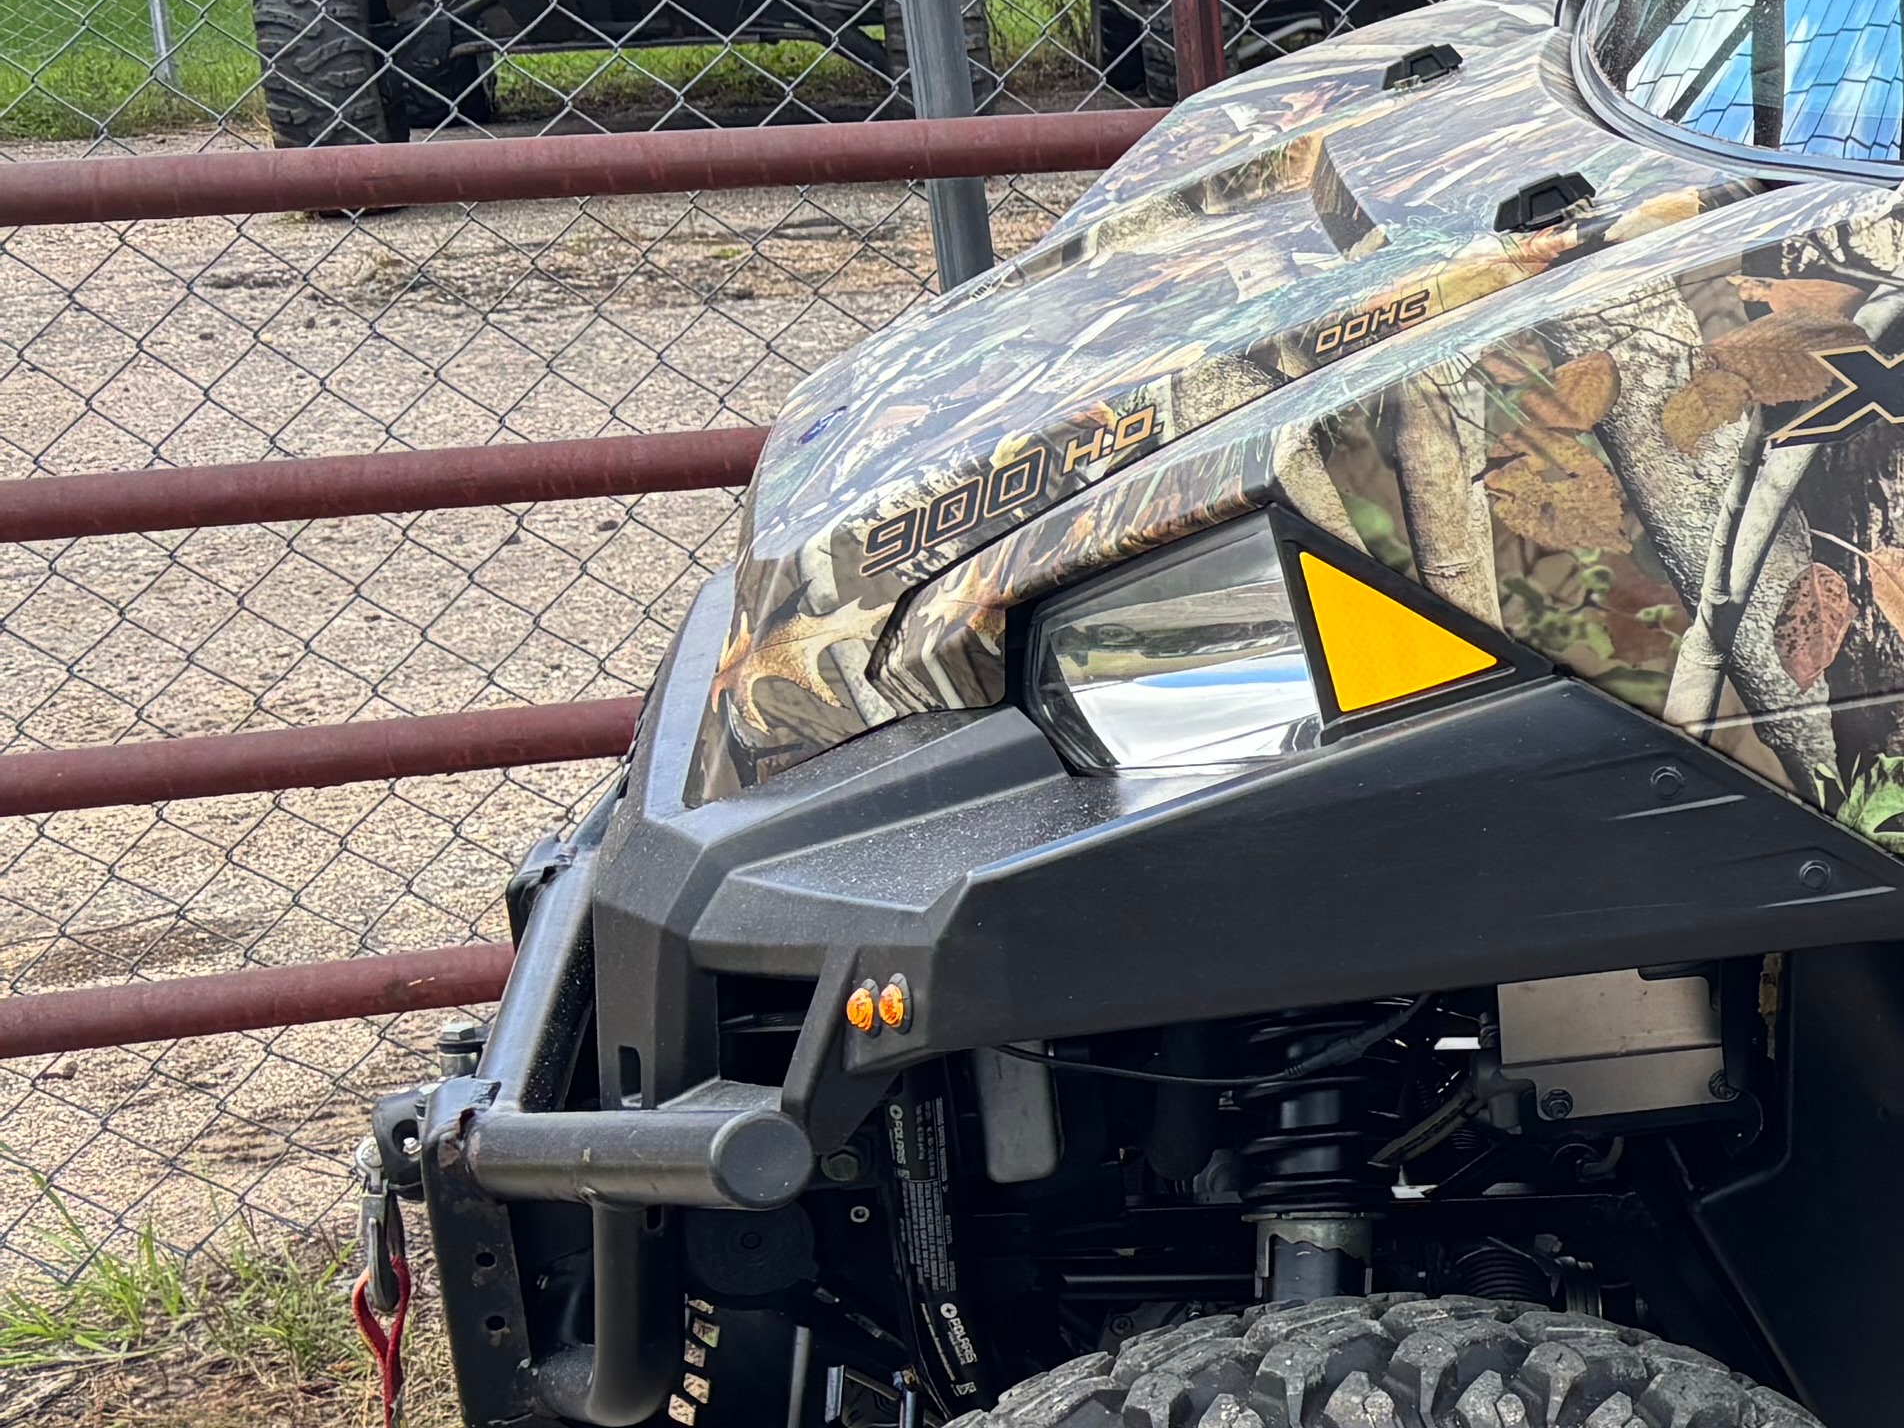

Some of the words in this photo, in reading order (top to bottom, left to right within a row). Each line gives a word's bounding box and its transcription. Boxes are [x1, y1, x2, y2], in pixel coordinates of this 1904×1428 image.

[859, 445, 1047, 578] 900
[1061, 404, 1165, 476] H.O.
[948, 1317, 978, 1364] POLARIS
